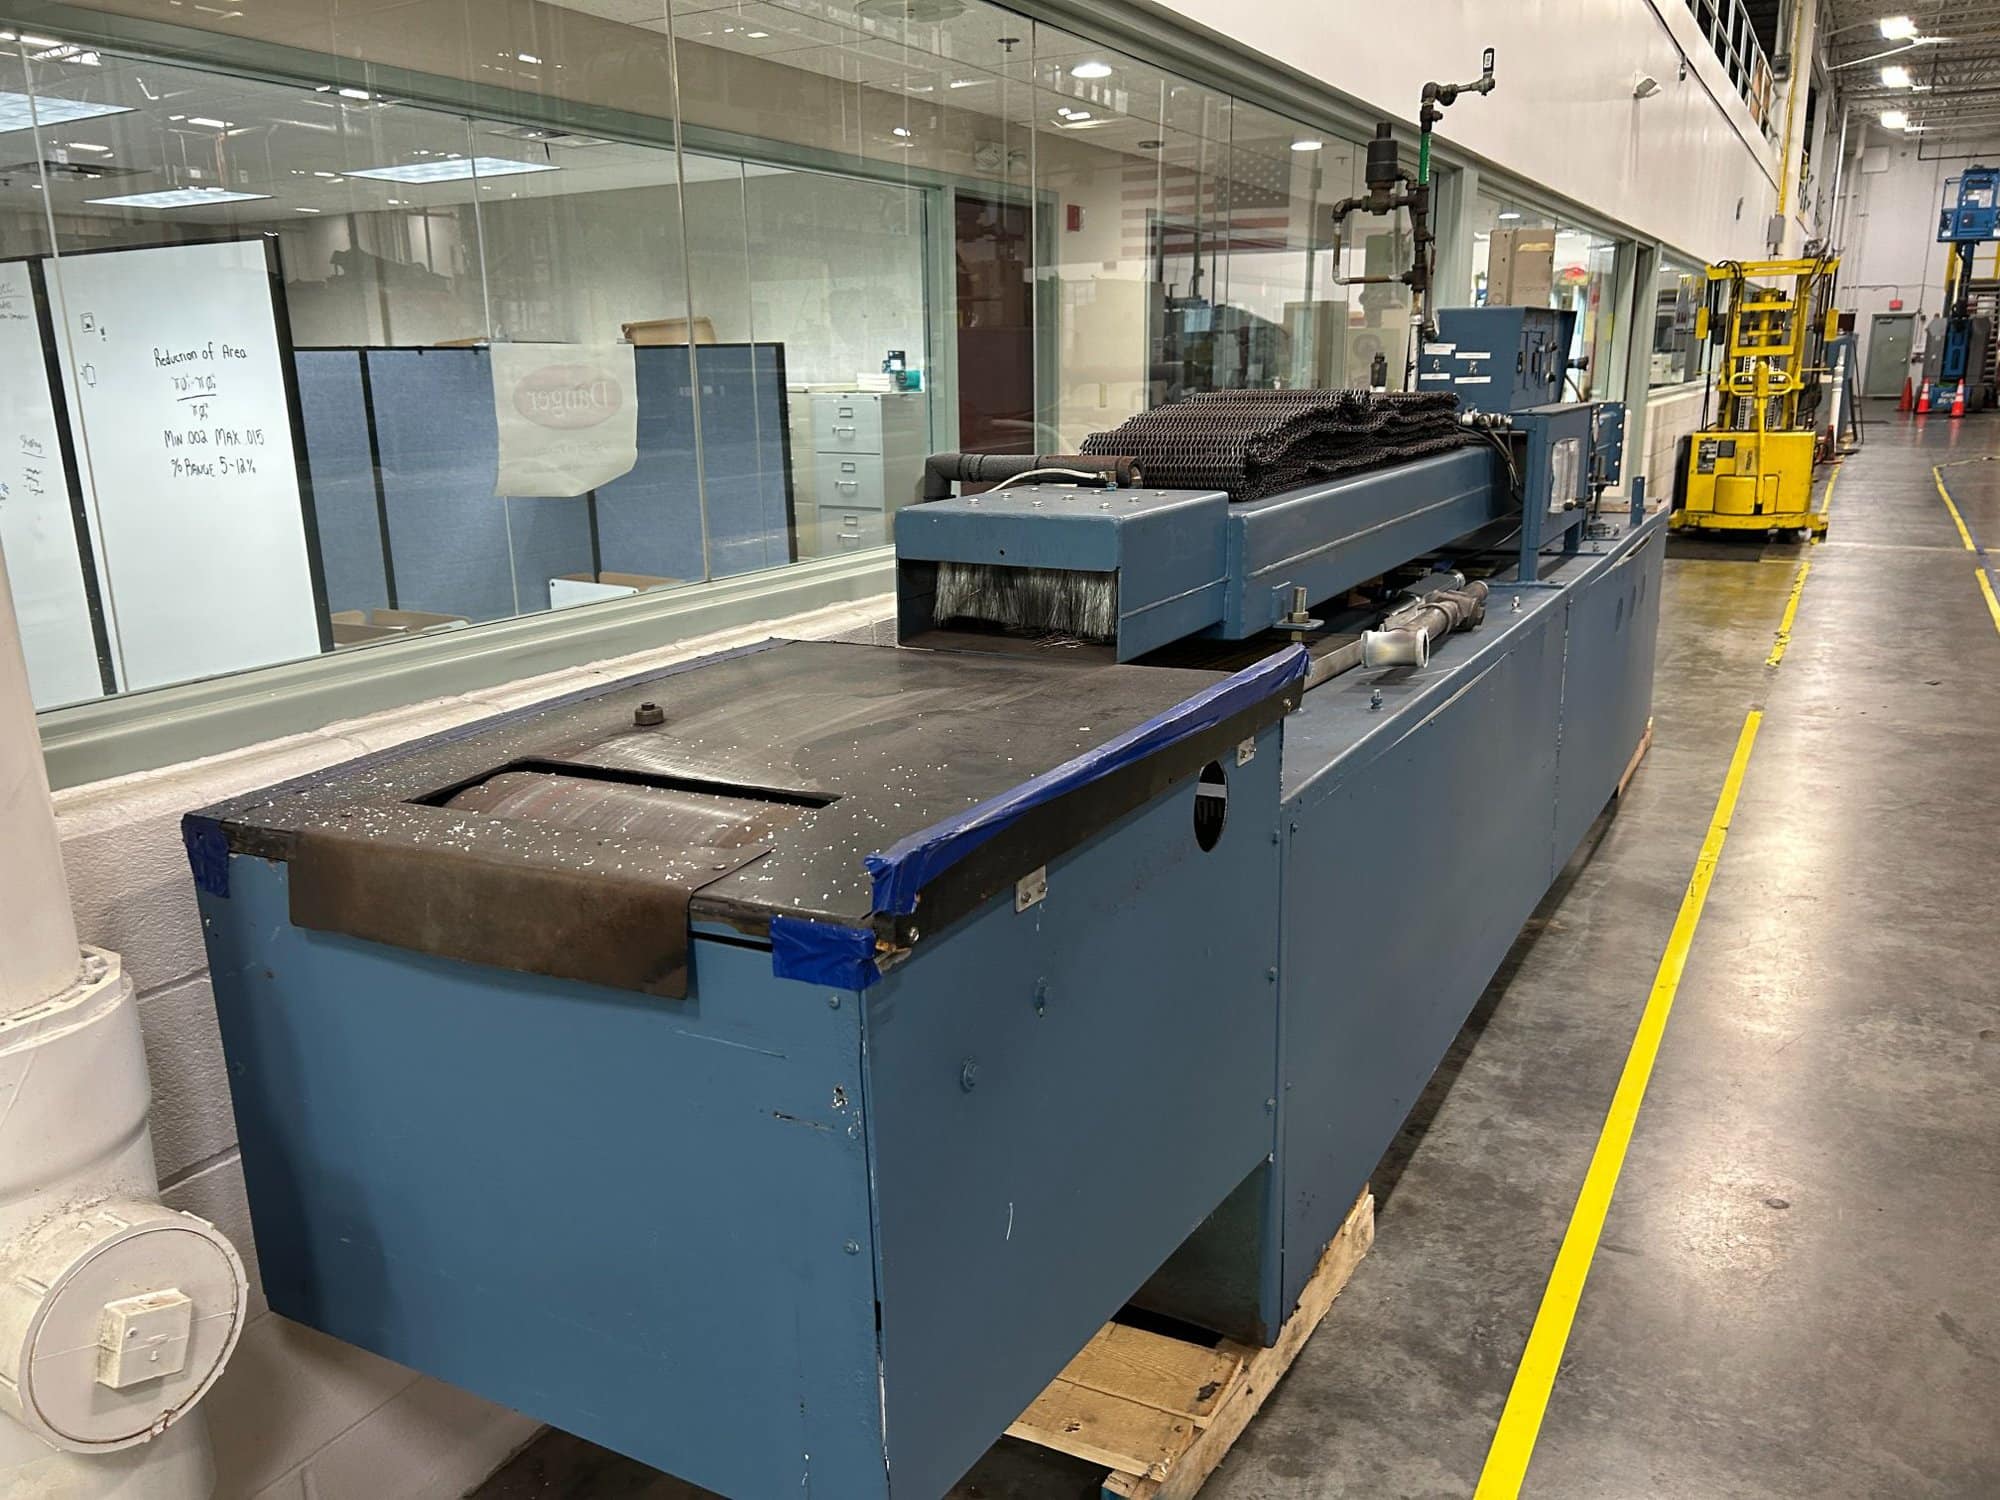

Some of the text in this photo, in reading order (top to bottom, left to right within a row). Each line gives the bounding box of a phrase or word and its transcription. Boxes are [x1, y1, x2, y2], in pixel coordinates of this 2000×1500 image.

[202, 341, 214, 360] of
[222, 344, 248, 360] Area
[215, 428, 241, 446] MAX
